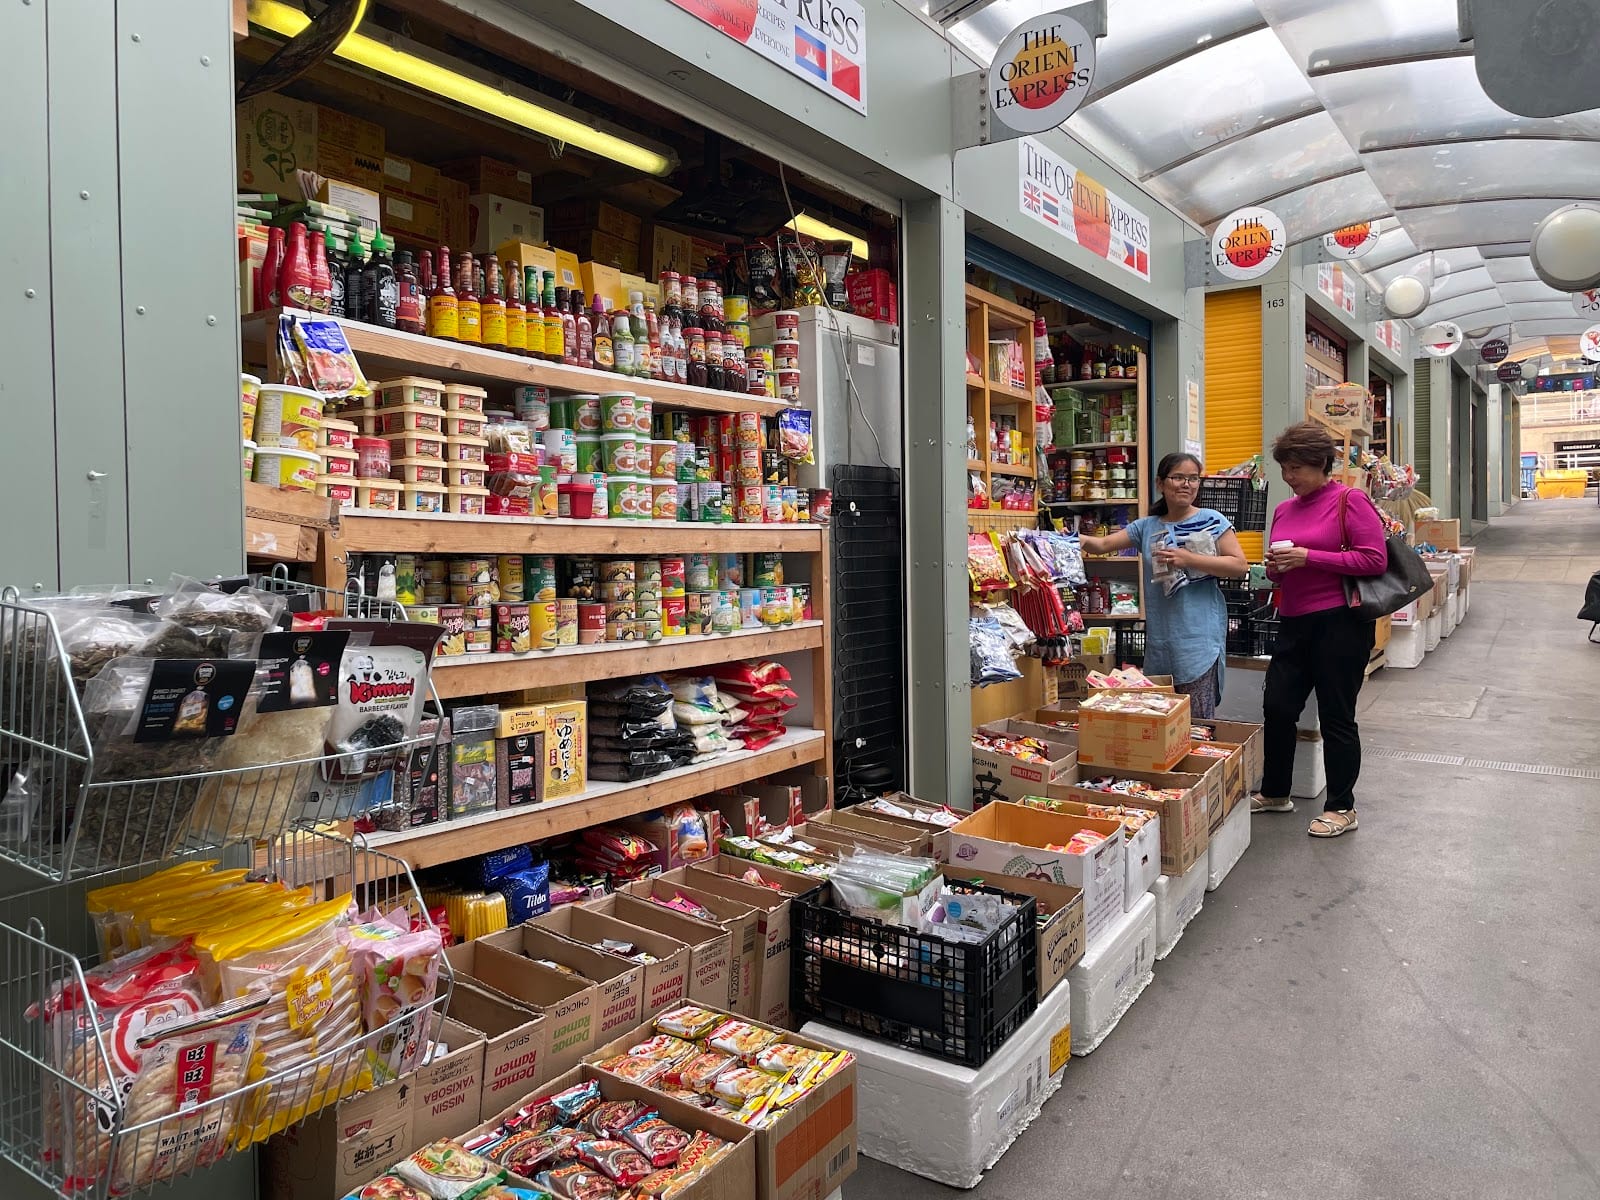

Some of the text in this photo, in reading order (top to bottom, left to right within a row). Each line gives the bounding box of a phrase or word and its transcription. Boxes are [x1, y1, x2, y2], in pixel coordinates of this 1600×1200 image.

[757, 5, 786, 30] RECIPES
[742, 21, 754, 34] TO
[755, 28, 790, 58] EVERYONE
[1019, 24, 1062, 51] THE
[999, 44, 1083, 82] ORIENT
[994, 68, 1090, 110] EXPRESS
[354, 157, 381, 173] MAMA
[1023, 142, 1052, 189] THE
[1054, 165, 1101, 219] ORIENT
[1104, 196, 1148, 248] EXPRESS
[1232, 215, 1263, 232] THE
[1218, 228, 1278, 250] ORIENT
[1326, 231, 1378, 247] EXPRESS
[1216, 244, 1283, 266] EXPRESS
[1347, 246, 1357, 255] 2
[1266, 298, 1285, 309] 163
[359, 702, 408, 713] BARBECUE FLAVOR
[1011, 766, 1041, 780] MULTI PACK
[503, 853, 518, 863] Tilda
[522, 894, 547, 908] Tilda
[659, 960, 680, 976] SPICY
[700, 970, 721, 988] NISSIN
[611, 986, 630, 1002] BEEF
[651, 974, 684, 996] Ramen
[555, 997, 590, 1019] CHICKEN
[602, 993, 638, 1018] Ramen
[650, 986, 683, 1010] Demae
[553, 1015, 591, 1040] Ramen
[601, 1008, 636, 1033] Demae
[503, 1034, 530, 1053] SPICY
[551, 1029, 590, 1053] Demae
[494, 1050, 537, 1077] Ramen
[491, 1065, 535, 1092] Demae
[423, 1075, 475, 1105] YAKISOBA
[396, 1099, 408, 1110] UP
[431, 1094, 465, 1116] NISSIN
[161, 1120, 218, 1147] WANT WANT
[490, 1130, 532, 1159] MAMA
[354, 1155, 375, 1168] Demae
[679, 1138, 714, 1171] MAMA
[643, 1167, 677, 1190] MAMA
